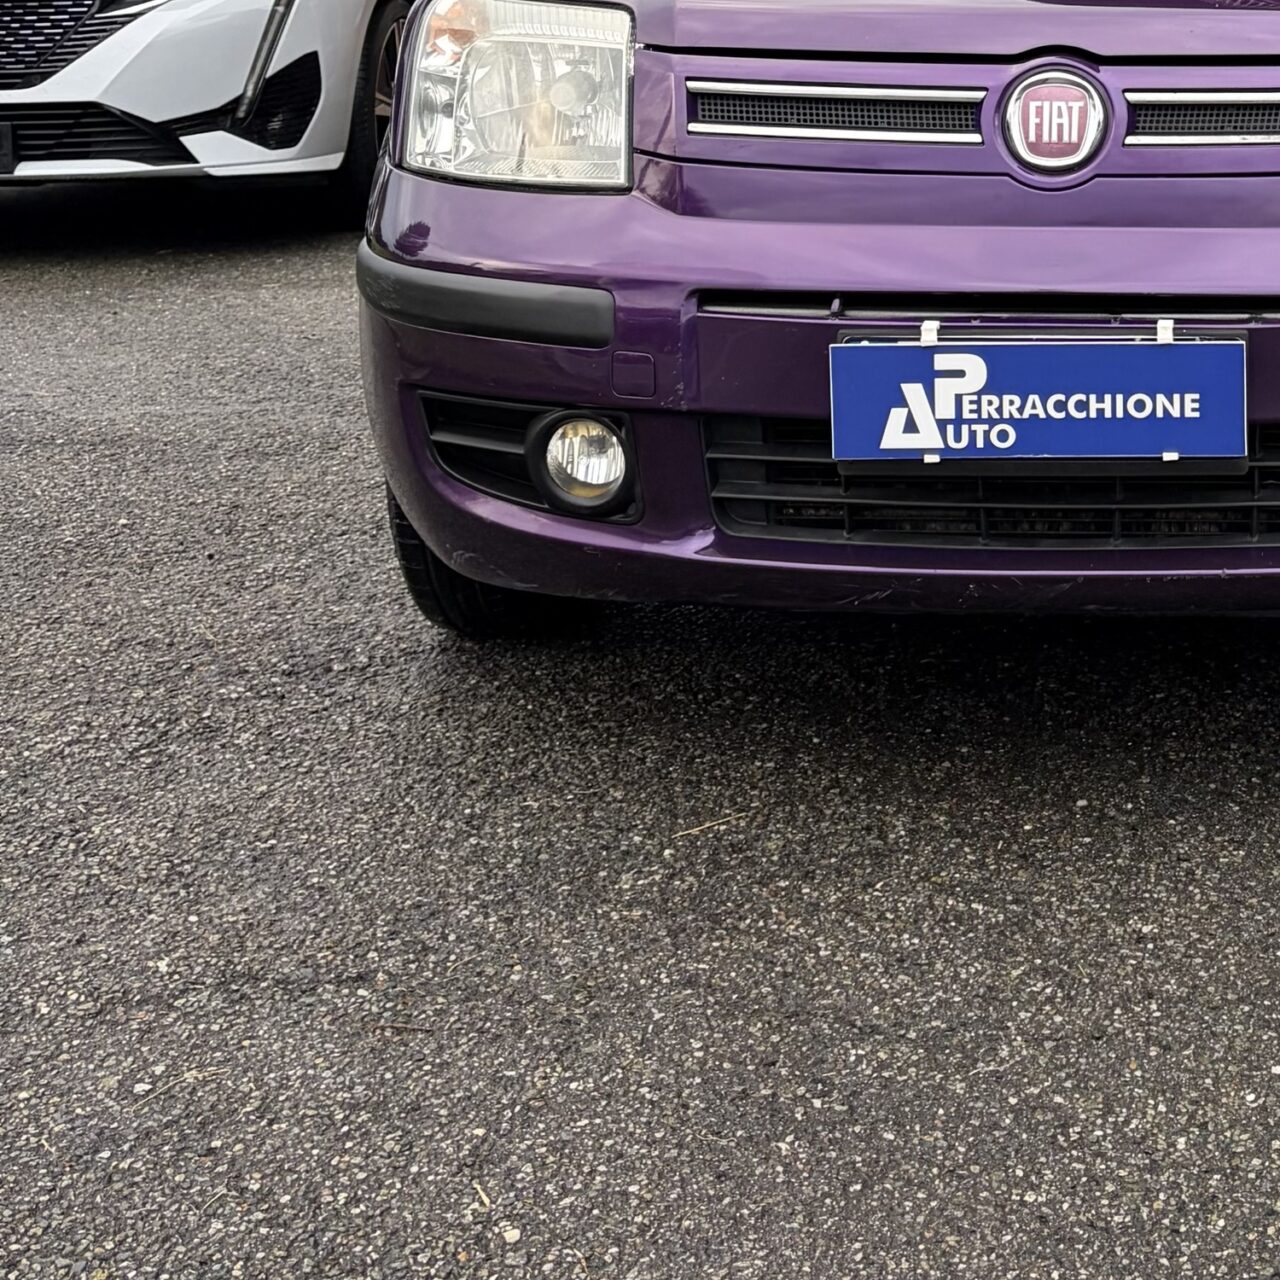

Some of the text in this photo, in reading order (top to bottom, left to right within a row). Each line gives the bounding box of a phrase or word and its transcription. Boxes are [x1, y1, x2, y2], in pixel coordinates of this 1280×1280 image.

[1028, 100, 1085, 144] FIAT
[879, 383, 1016, 450] AUTO
[933, 353, 1200, 420] PERRACCHIONE
